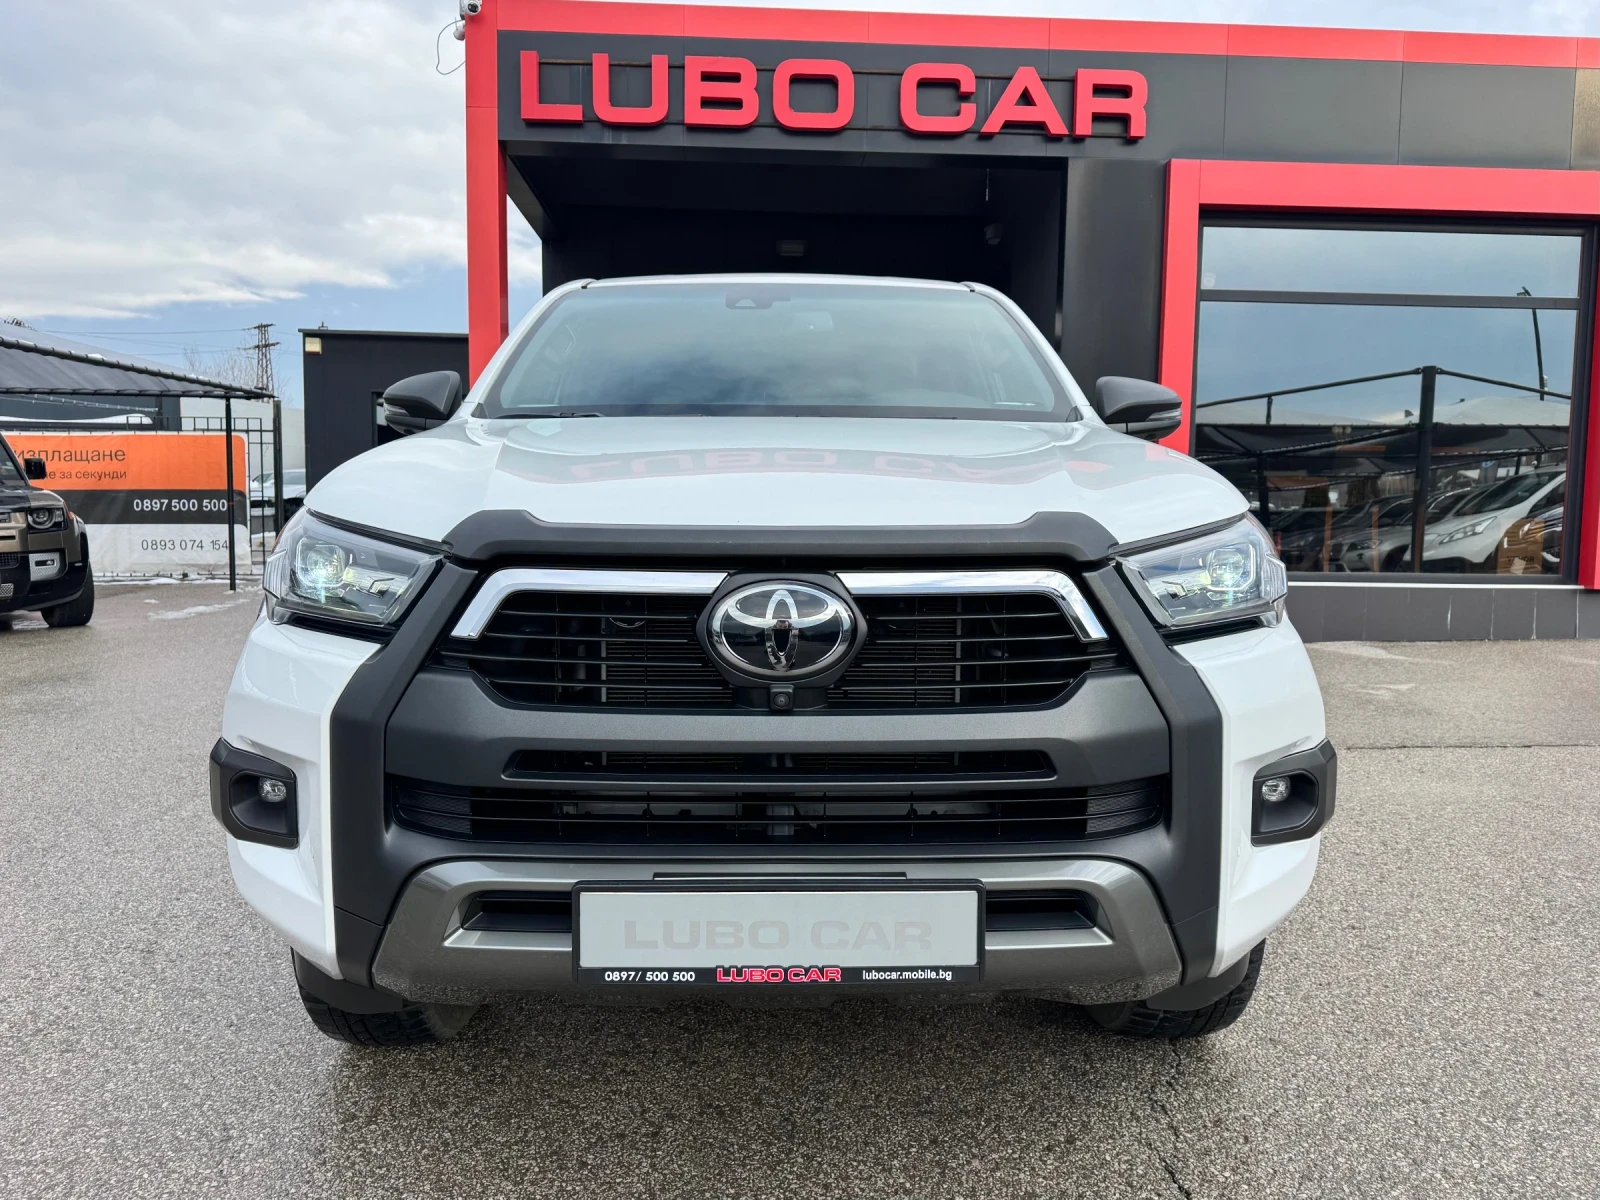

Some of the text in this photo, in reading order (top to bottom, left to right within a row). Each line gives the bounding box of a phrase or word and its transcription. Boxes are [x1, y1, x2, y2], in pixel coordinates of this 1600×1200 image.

[520, 50, 1148, 139] LUBO CAR
[60, 471, 72, 479] за
[75, 470, 127, 480] секунди
[133, 499, 228, 511] 0897 500 500
[141, 540, 229, 551] 0893 074 154
[624, 920, 932, 950] LUBO CAR
[604, 971, 695, 982] 0897/ 500 500
[716, 967, 842, 983] LUBO CAR
[862, 969, 952, 981] lubocar.mobile.bg
